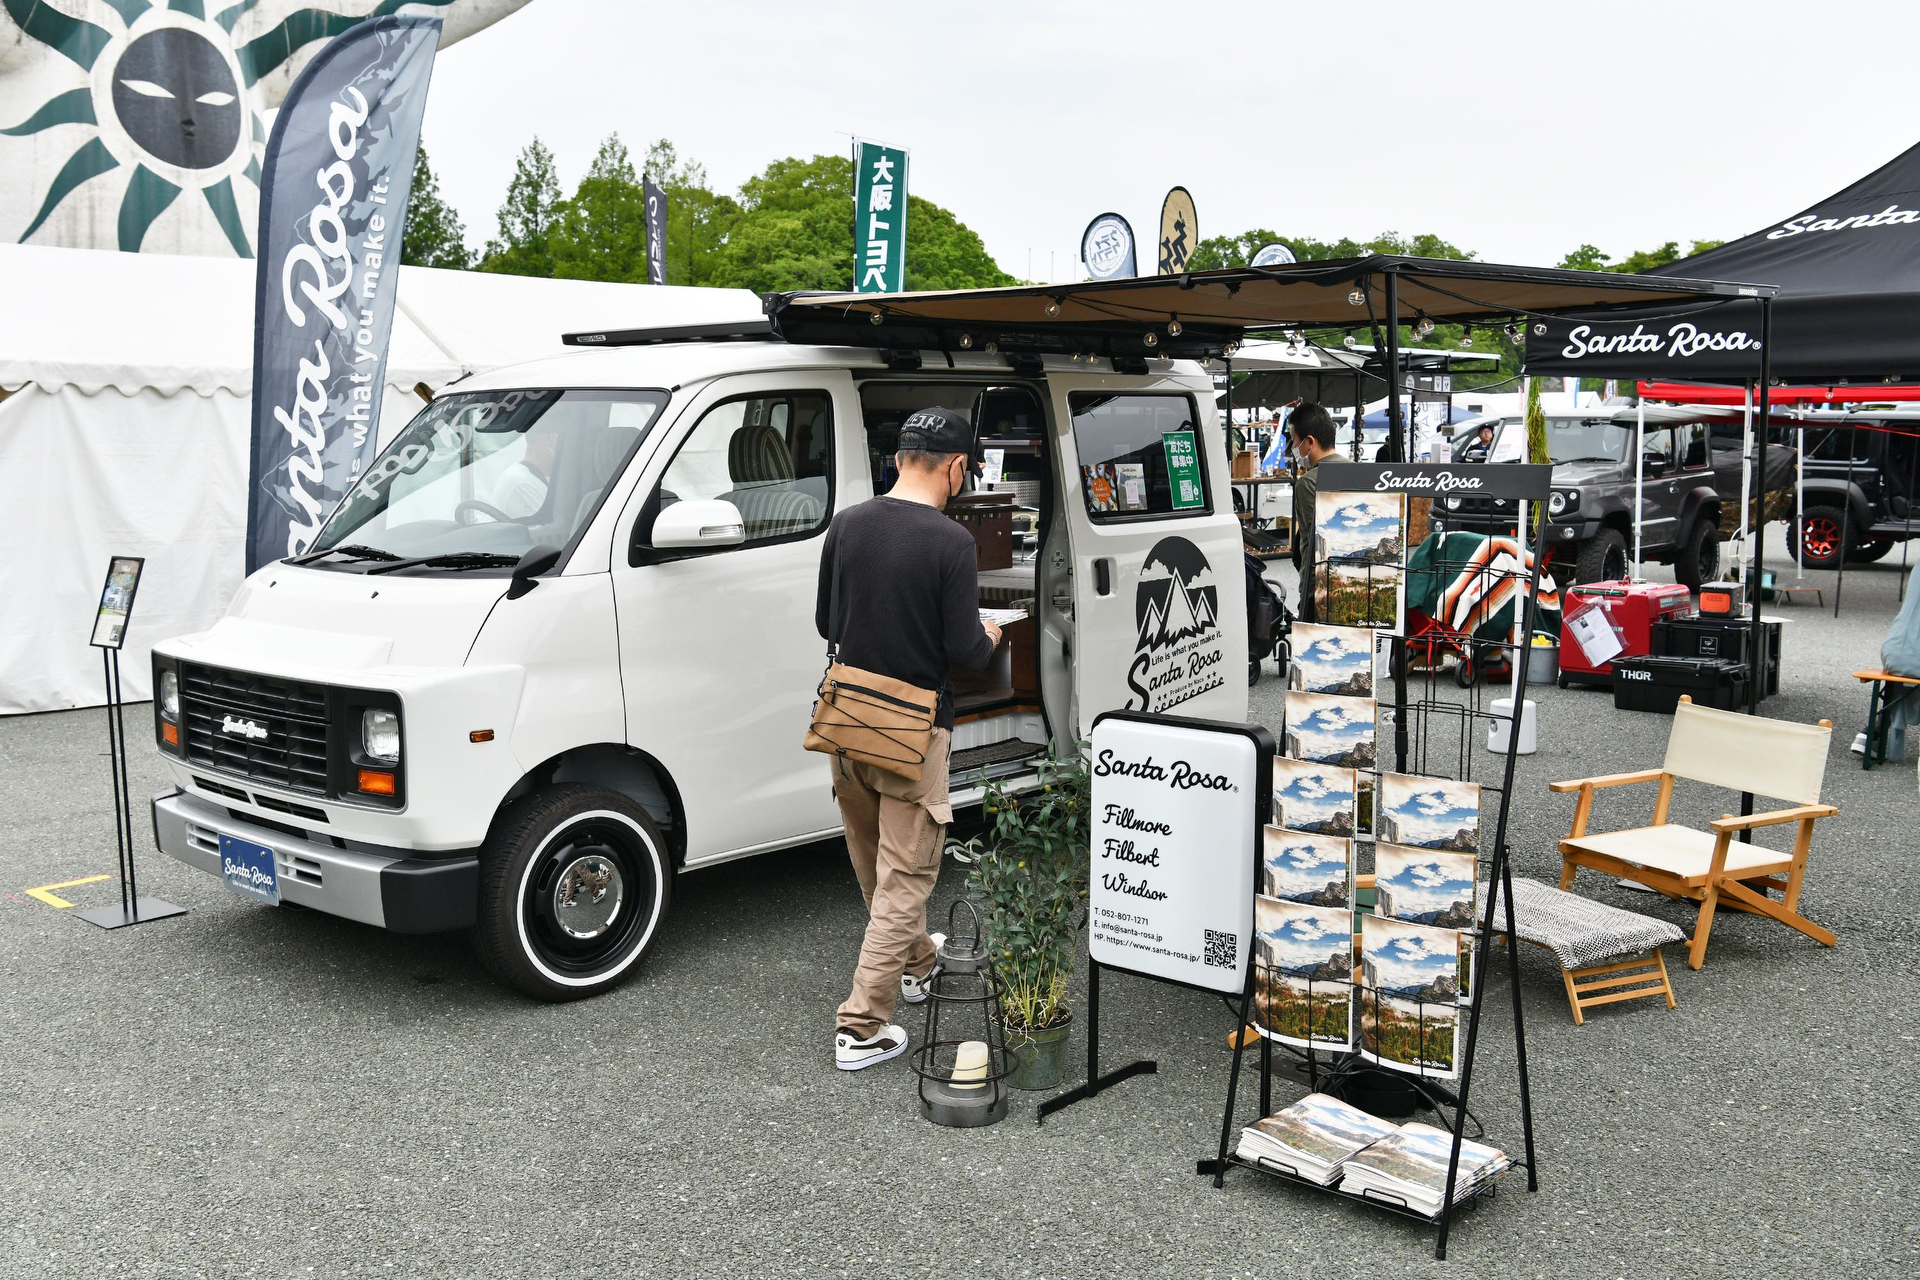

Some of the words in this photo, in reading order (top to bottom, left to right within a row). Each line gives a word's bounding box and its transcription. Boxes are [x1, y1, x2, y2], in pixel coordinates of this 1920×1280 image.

[282, 86, 369, 331] Rosa
[862, 155, 894, 292] 大阪トヨペ
[1766, 204, 1920, 240] Santa
[362, 214, 386, 299] make
[355, 310, 378, 363] you
[1562, 325, 1666, 359] Santa
[345, 372, 373, 448] what
[1170, 440, 1192, 454] 友だち
[1374, 470, 1435, 492] Santa
[1435, 471, 1484, 492] Rosa
[1151, 655, 1164, 666] Life
[1165, 652, 1171, 661] is
[1171, 644, 1187, 657] what
[1187, 641, 1199, 652] you
[1199, 633, 1216, 646] make
[1124, 653, 1185, 713] Santa
[1187, 649, 1223, 679] Rosa
[1620, 669, 1652, 682] THOR
[1094, 749, 1168, 781] Santa
[1102, 803, 1173, 836] Fillmore
[1101, 838, 1160, 868] Filbert
[224, 857, 251, 879] Santa
[250, 865, 274, 886] Rosa
[1102, 872, 1168, 901] Windsor
[1094, 907, 1100, 916] T.
[1101, 908, 1149, 926] 052-807-1271
[1094, 919, 1100, 928] E.
[1101, 921, 1163, 943] info@santa-rosa.jp
[1094, 932, 1105, 942] HP.
[1106, 935, 1201, 963] https://www.santa-rosa.jp/
